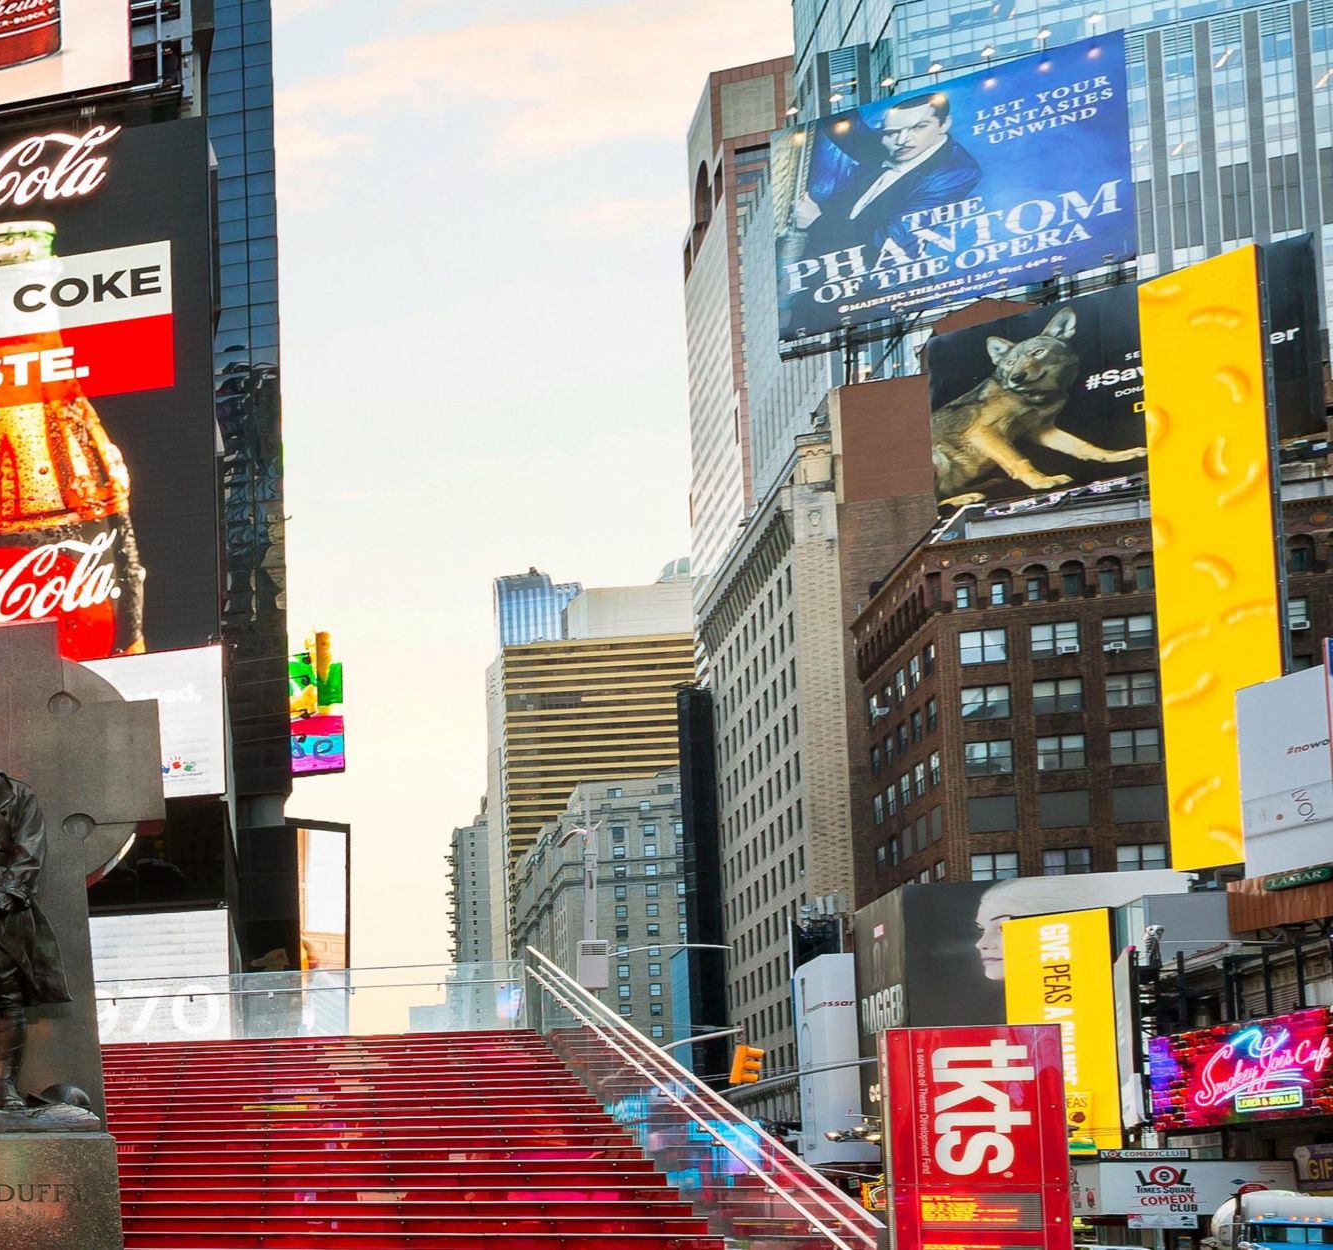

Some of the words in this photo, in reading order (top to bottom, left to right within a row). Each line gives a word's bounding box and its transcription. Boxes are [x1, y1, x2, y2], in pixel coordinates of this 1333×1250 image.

[971, 87, 1114, 137] FANTASIES
[975, 99, 1025, 122] LET
[1036, 75, 1111, 104] YOUR
[987, 106, 1098, 145] UNWIND
[901, 195, 986, 232] THE
[783, 178, 1123, 295] PHANTOM
[813, 275, 865, 304] OF
[869, 254, 951, 291] THE
[955, 224, 1092, 271] OPERA
[13, 264, 162, 313] COKE
[1039, 923, 1070, 962] GIVE
[1042, 963, 1072, 1004] PEAS
[861, 984, 904, 1036] DAGGER
[1043, 1007, 1073, 1021] A
[1194, 1043, 1260, 1107] Smokey
[920, 1087, 928, 1112] Theatre
[931, 1038, 1035, 1177] tkts
[1067, 1096, 1088, 1109] EAS
[920, 1113, 930, 1157] Development
[923, 1158, 931, 1175] Fund
[1135, 1165, 1191, 1188] LOL
[1135, 1185, 1162, 1194] TIMES
[1162, 1185, 1197, 1195] SQUARE
[1140, 1194, 1196, 1206] COMEDY
[1170, 1203, 1199, 1213] CLUB
